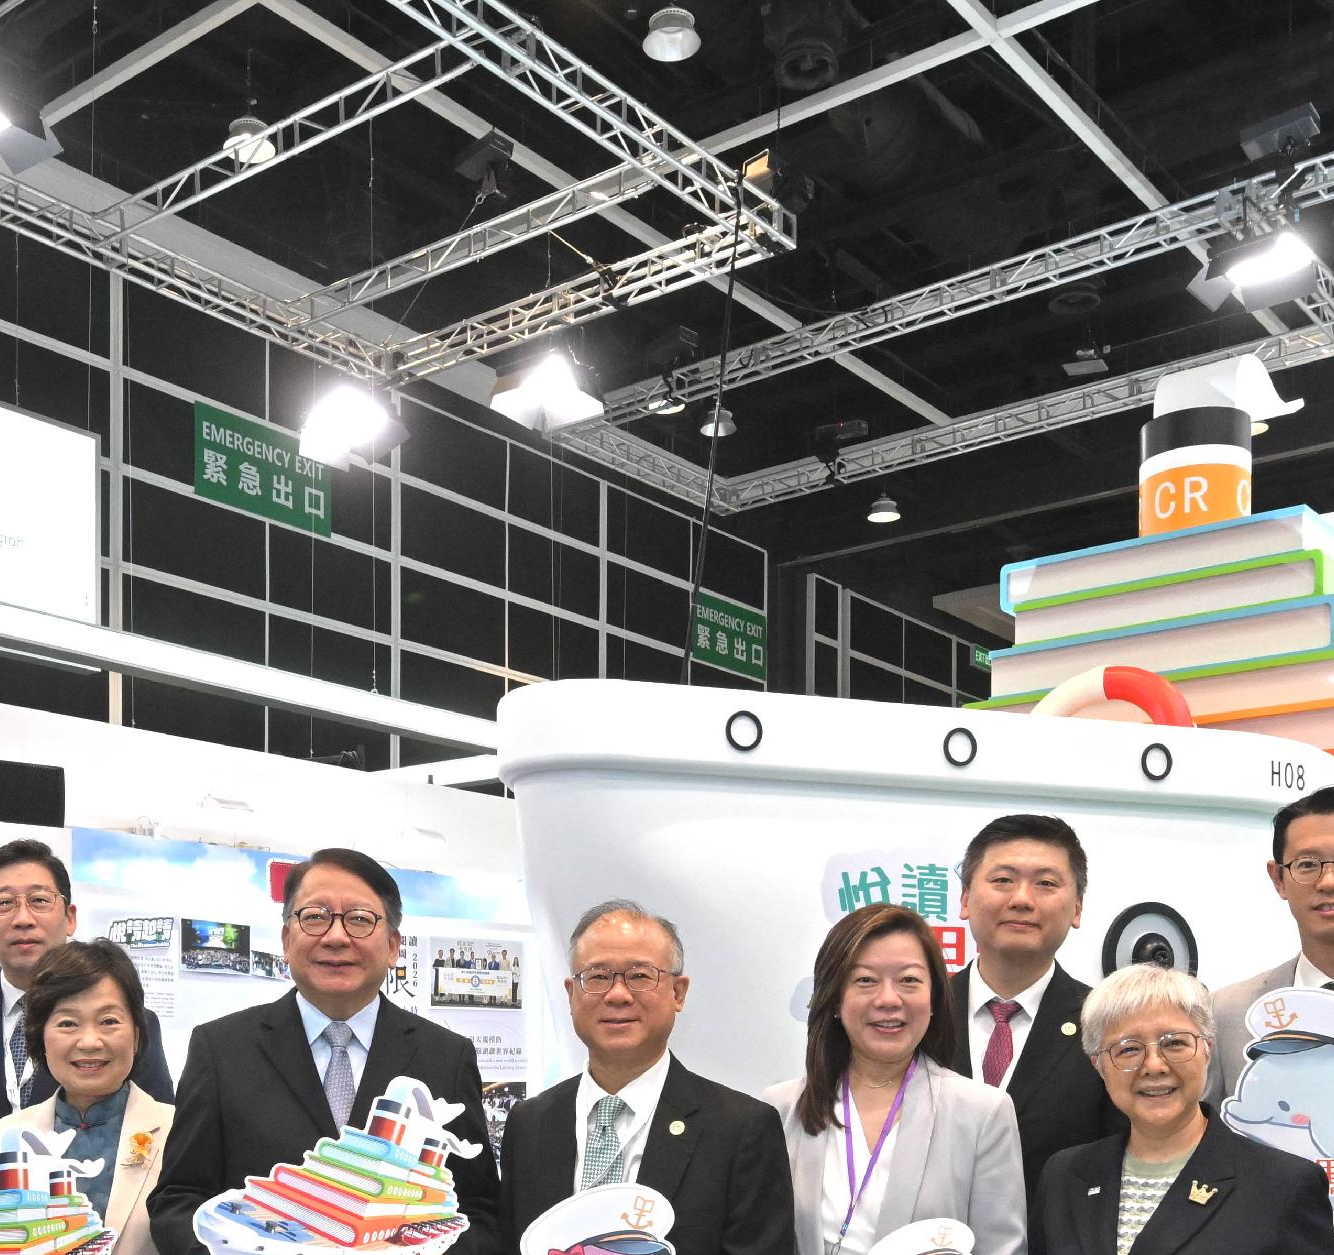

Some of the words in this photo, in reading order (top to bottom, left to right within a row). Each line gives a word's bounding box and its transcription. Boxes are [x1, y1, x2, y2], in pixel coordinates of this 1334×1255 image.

[202, 420, 291, 469] EMERGENCY
[295, 455, 325, 481] EXIT
[203, 447, 325, 520] 緊急出口
[1154, 475, 1209, 520] CR
[696, 604, 745, 633] EMERGENCY
[747, 622, 763, 639] EXIT
[696, 623, 763, 667] 緊急出口
[1270, 759, 1306, 791] H08
